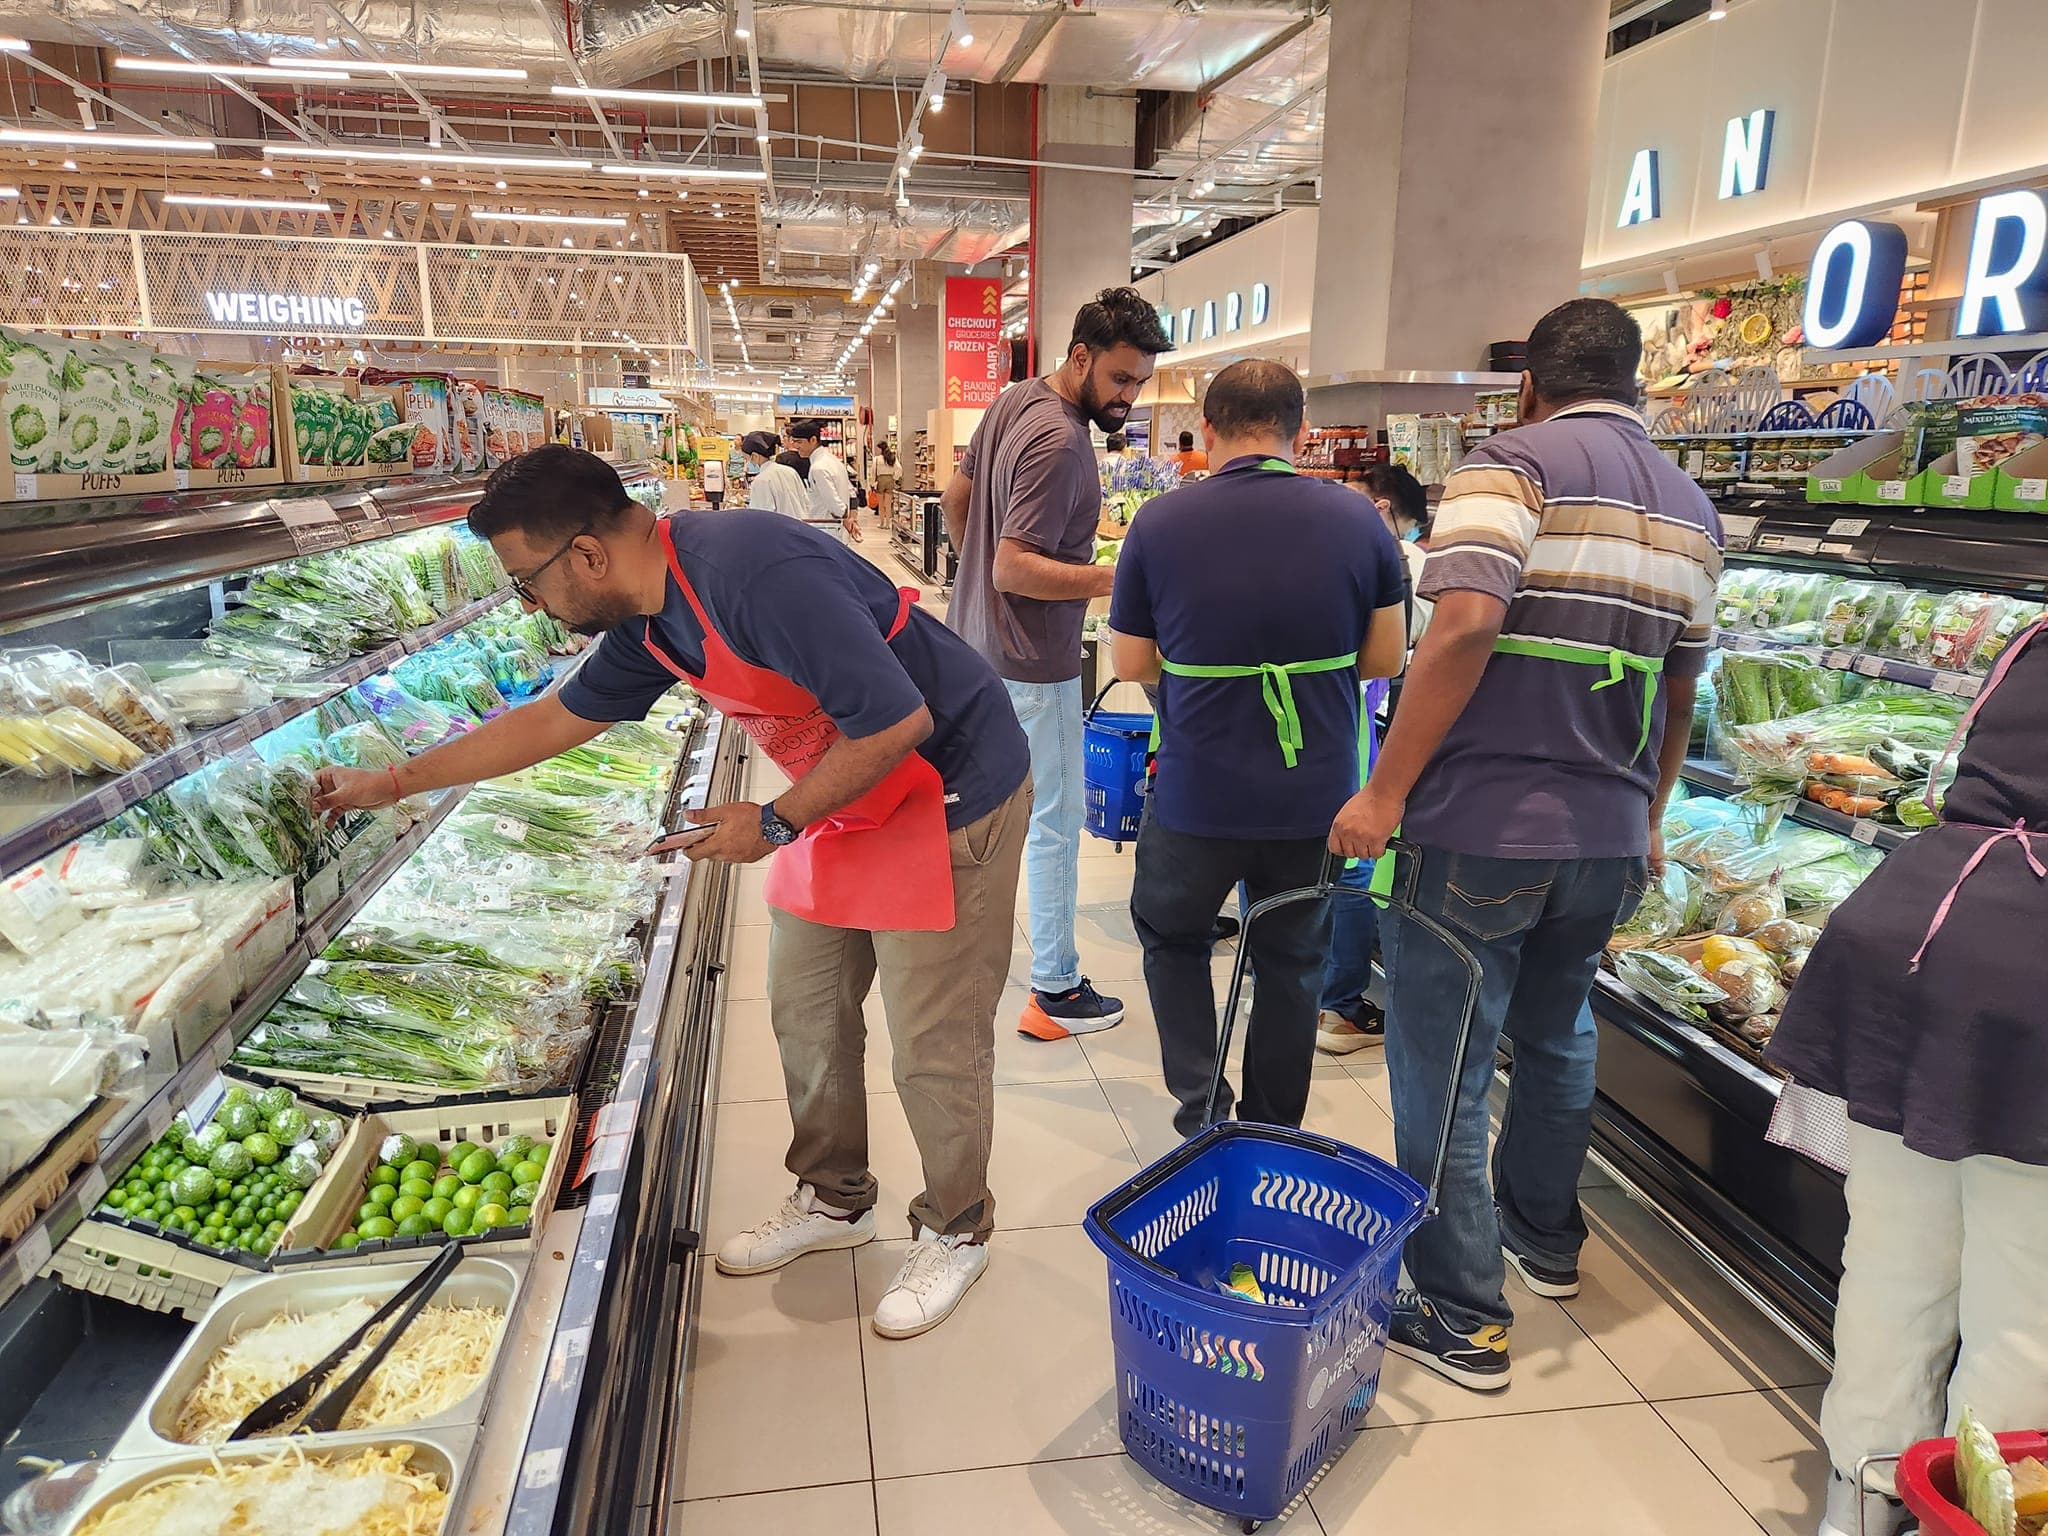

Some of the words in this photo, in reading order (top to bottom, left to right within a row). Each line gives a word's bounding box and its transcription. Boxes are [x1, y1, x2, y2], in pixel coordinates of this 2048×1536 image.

[206, 292, 365, 326] WEIGHING
[948, 317, 997, 329] CHECKOUT
[955, 330, 997, 339] GROCERIES
[948, 340, 985, 352] FROZEN
[986, 342, 998, 379] DAIRY
[5, 383, 59, 402] CAULIFLOWER
[963, 381, 997, 391] BAKING
[406, 393, 432, 409] PEH
[1963, 415, 1993, 424] MIXED
[217, 469, 246, 483] PUFFS
[326, 466, 344, 477] PUFFS
[81, 472, 121, 490] PUFFS
[1345, 1323, 1371, 1359] FOOD
[1327, 1322, 1383, 1389] MERCHANT
